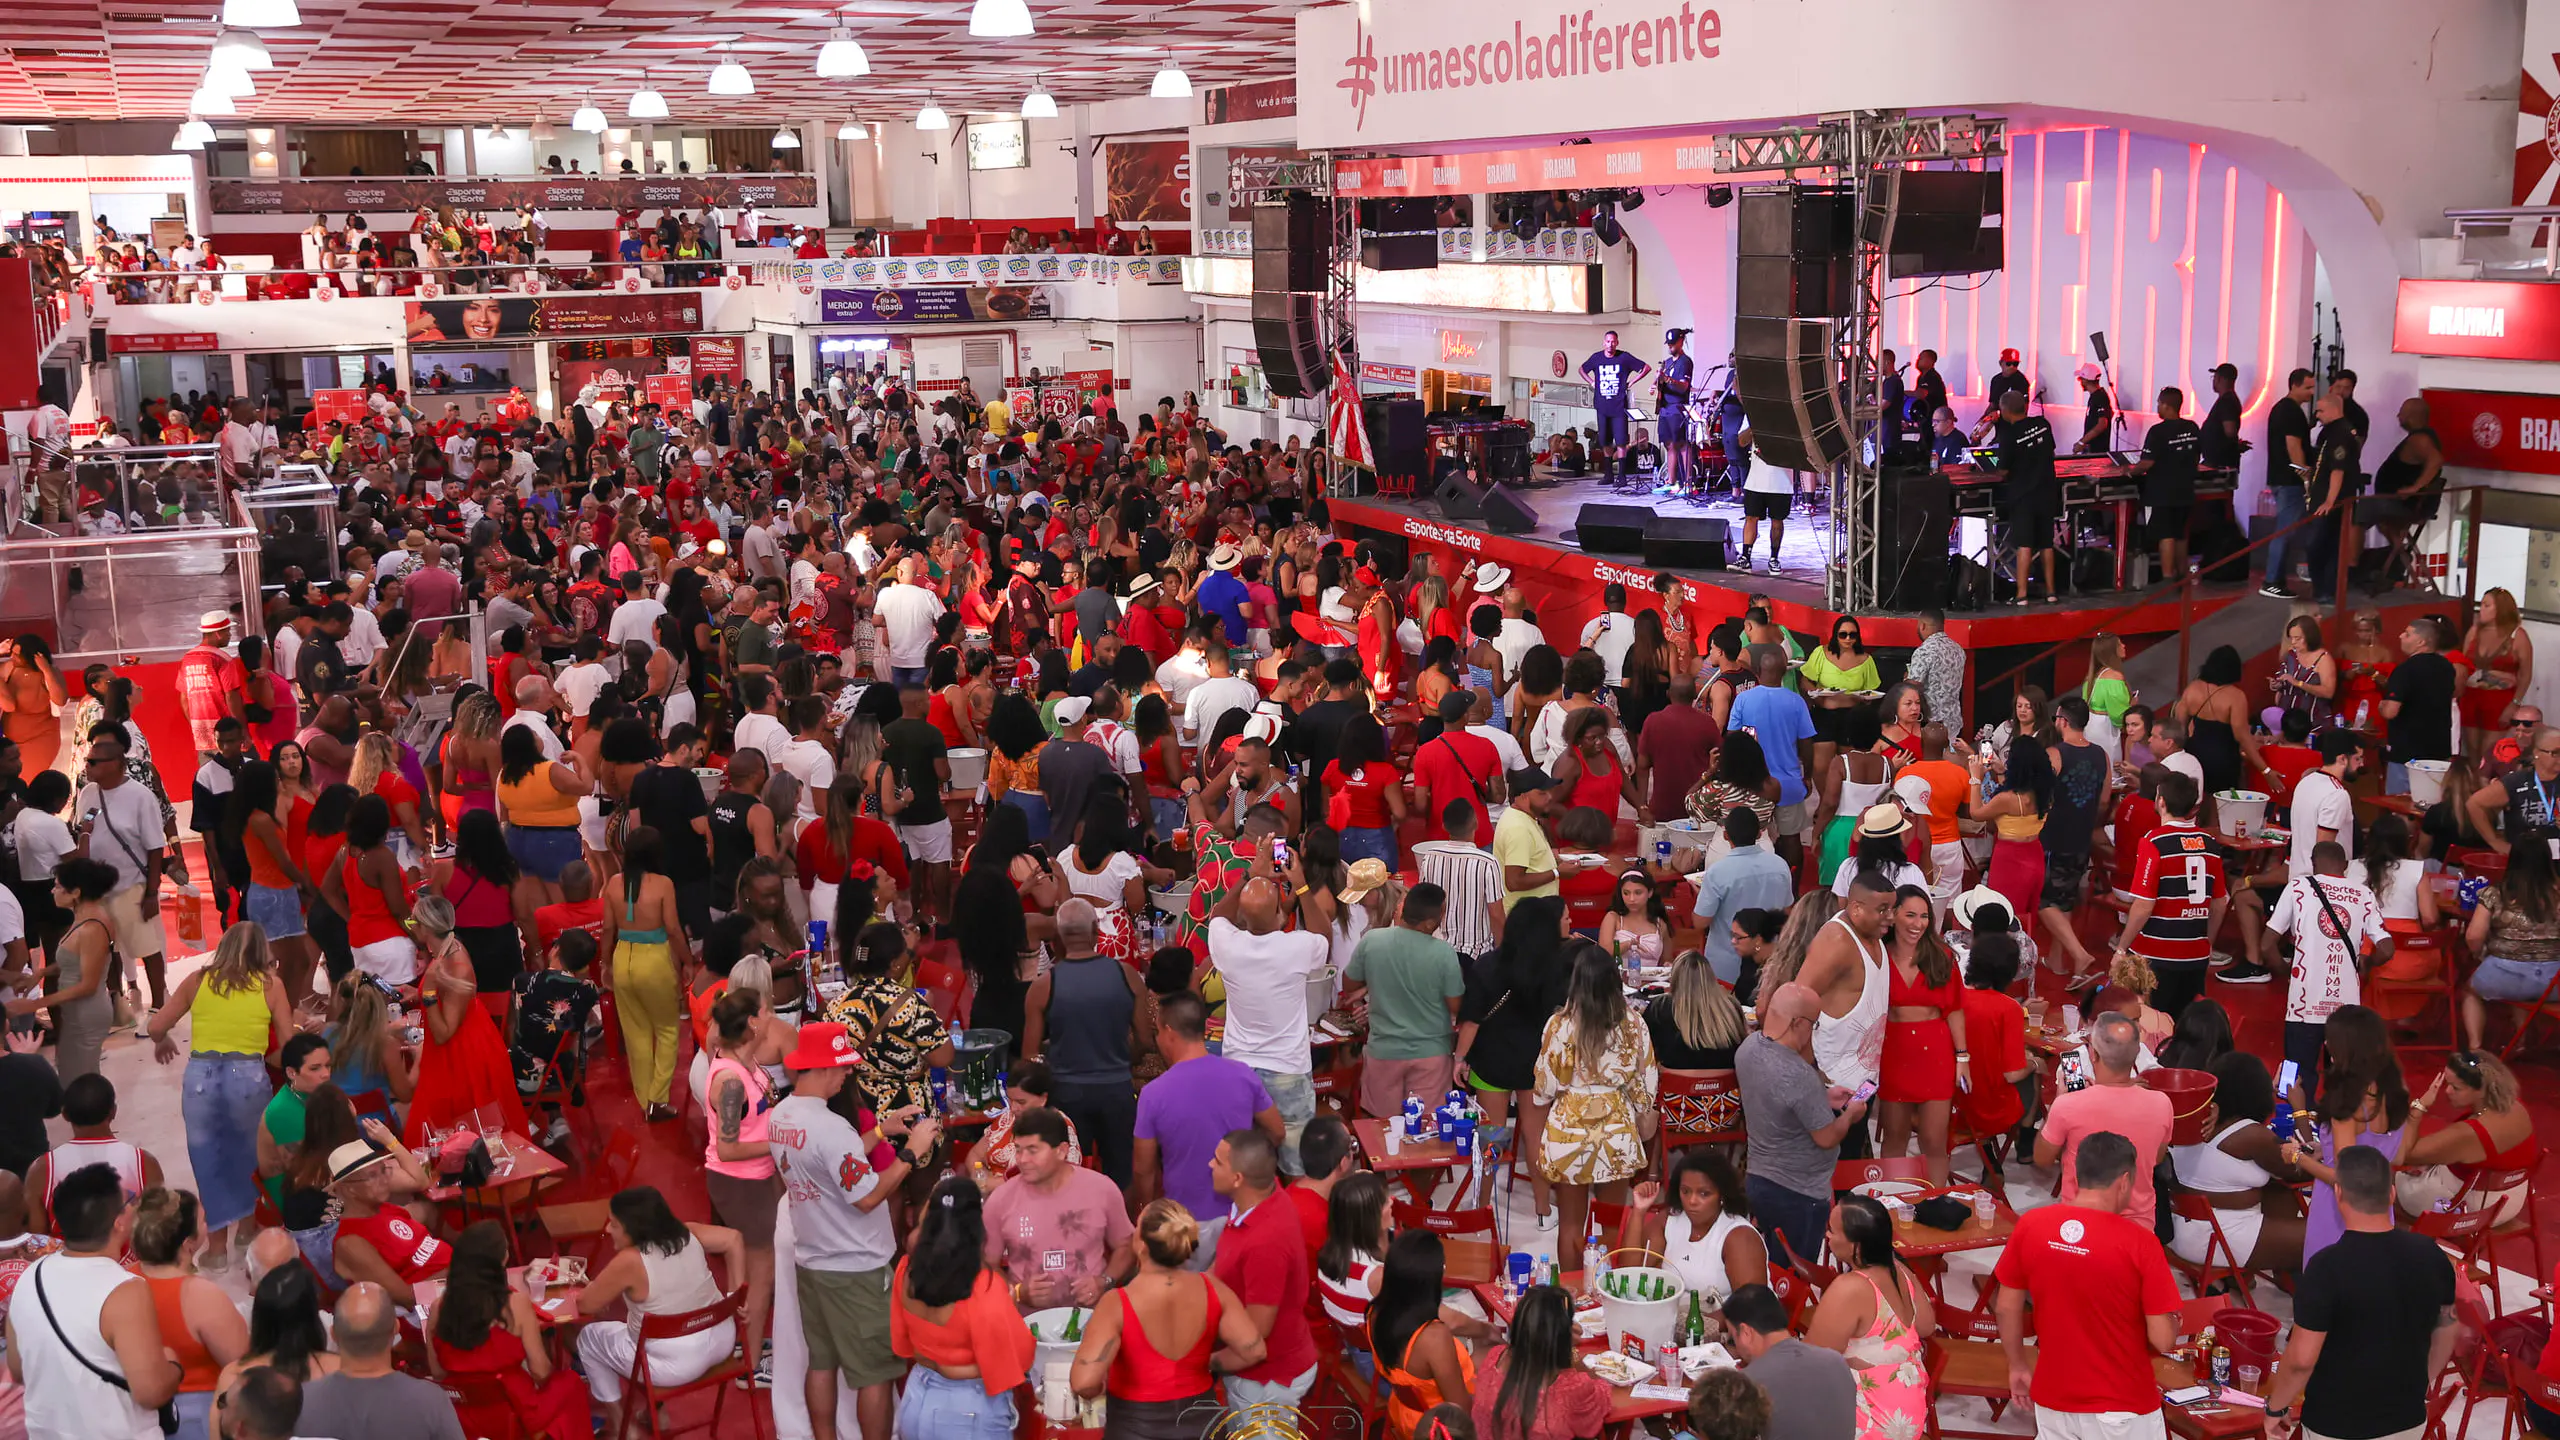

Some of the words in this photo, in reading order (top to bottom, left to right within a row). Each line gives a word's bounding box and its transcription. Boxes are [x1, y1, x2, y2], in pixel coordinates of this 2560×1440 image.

[1337, 1, 1721, 131] #umaescoladiferente
[1256, 98, 1268, 108] Vult
[1544, 157, 1576, 179] BRAHMA
[1607, 152, 1642, 175] BRAHMA
[1337, 171, 1361, 189] BRAHMA
[1383, 168, 1408, 187] BRAHMA
[1433, 166, 1460, 185] BRAHMA
[1487, 163, 1517, 184] BRAHMA
[446, 188, 486, 197] Esportes
[545, 187, 585, 196] Esportes
[548, 194, 559, 203] da
[560, 194, 583, 203] Sorte
[643, 186, 682, 195] Esportes
[645, 193, 657, 202] da
[658, 193, 680, 202] Sorte
[449, 195, 460, 203] da
[461, 195, 485, 203] Sorte
[827, 301, 863, 310] MERCADO
[872, 303, 904, 311] Feijoada
[2428, 305, 2505, 337] BRAHMA
[1080, 372, 1098, 380] SAÍDA
[1404, 517, 1444, 543] Esportes
[1444, 529, 1455, 545] da
[1455, 530, 1481, 551] Sorte
[1594, 561, 1646, 591] Esportes
[2185, 856, 2206, 904] 9
[2328, 891, 2359, 905] Sorte
